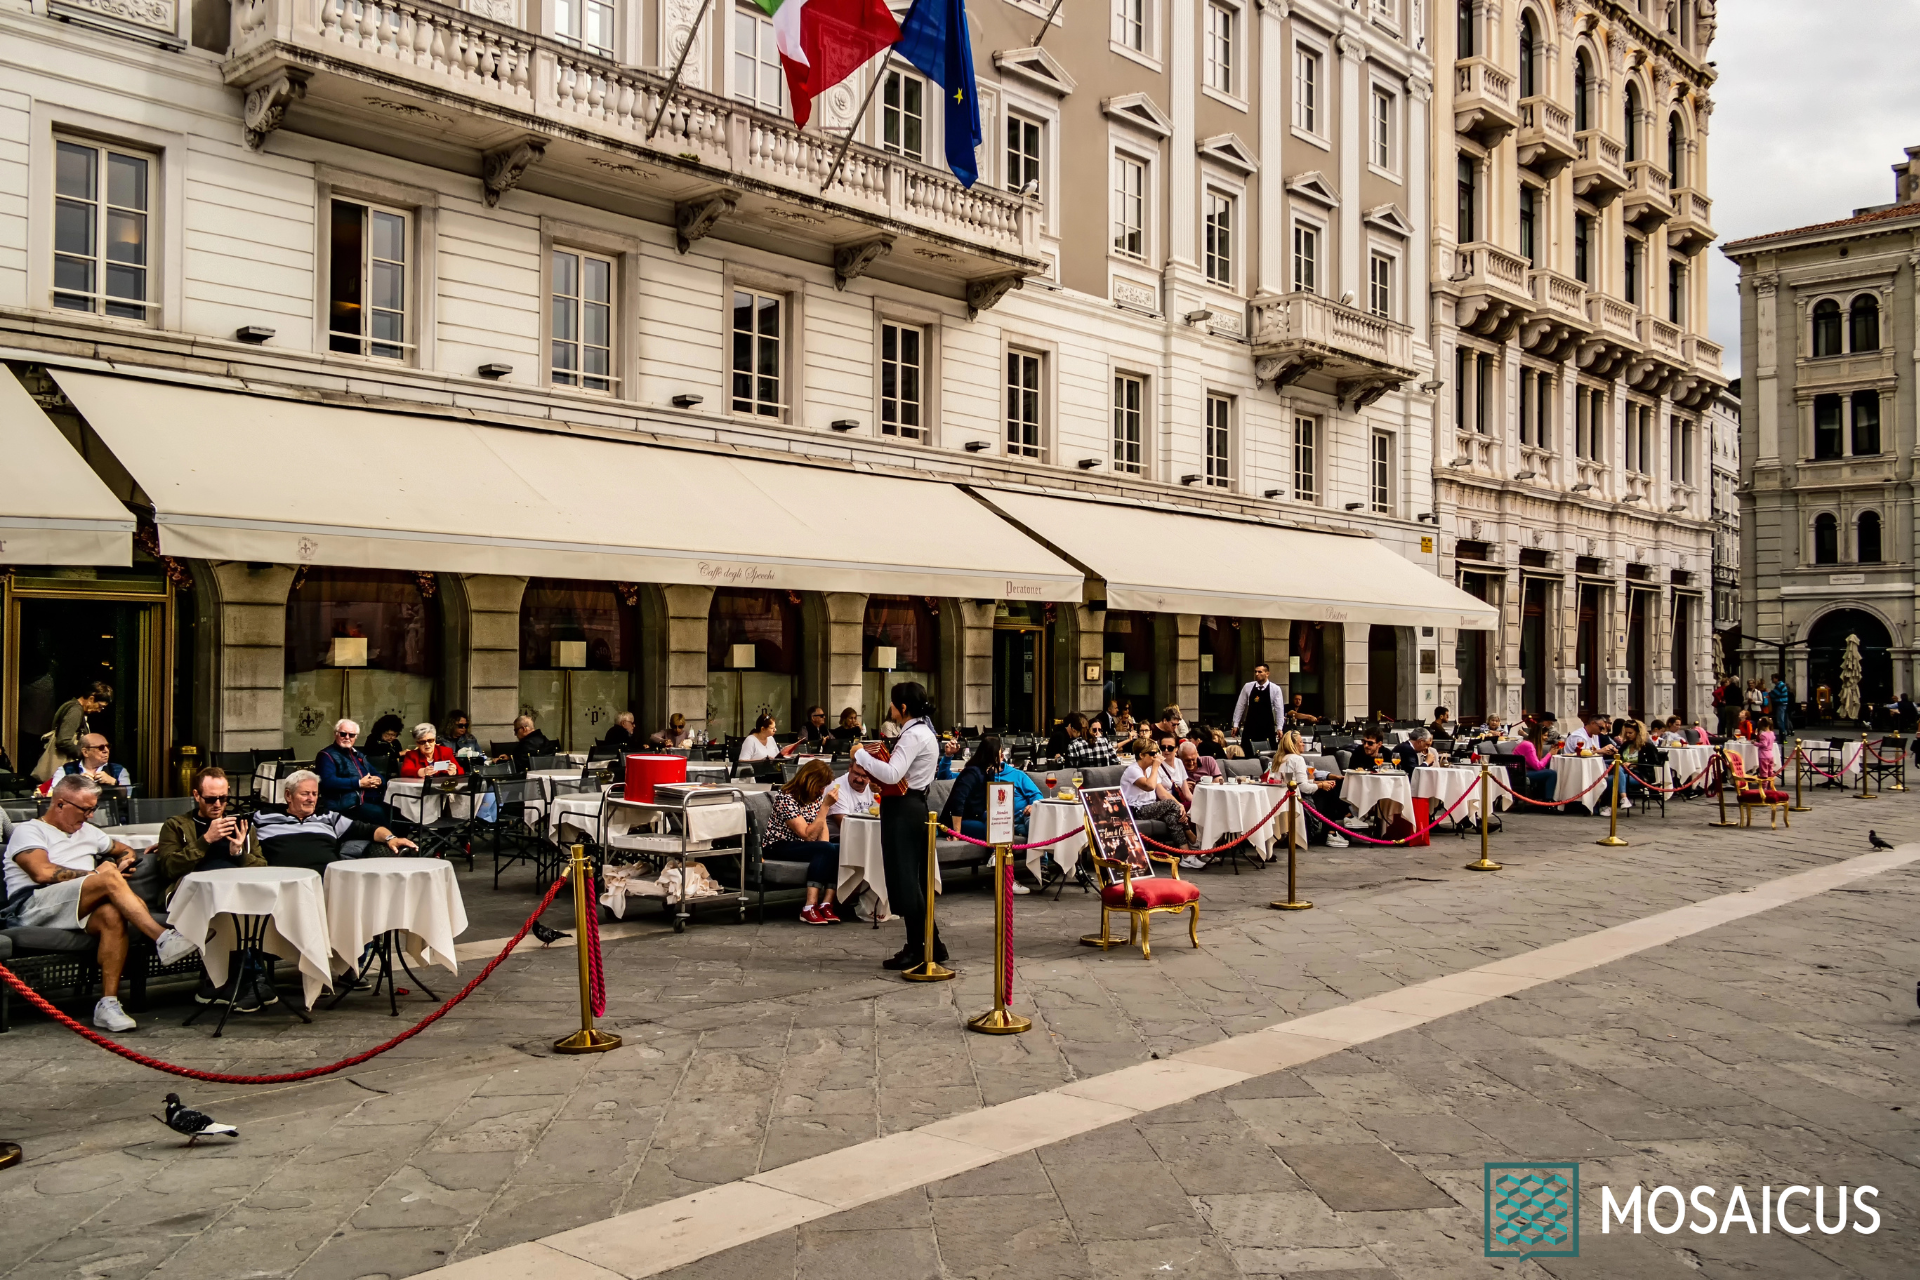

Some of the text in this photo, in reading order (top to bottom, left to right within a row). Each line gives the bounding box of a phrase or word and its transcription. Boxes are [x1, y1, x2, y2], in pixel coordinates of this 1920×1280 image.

[723, 567, 742, 583] degli
[745, 566, 775, 583] Specchi
[1006, 581, 1042, 597] Peratoner
